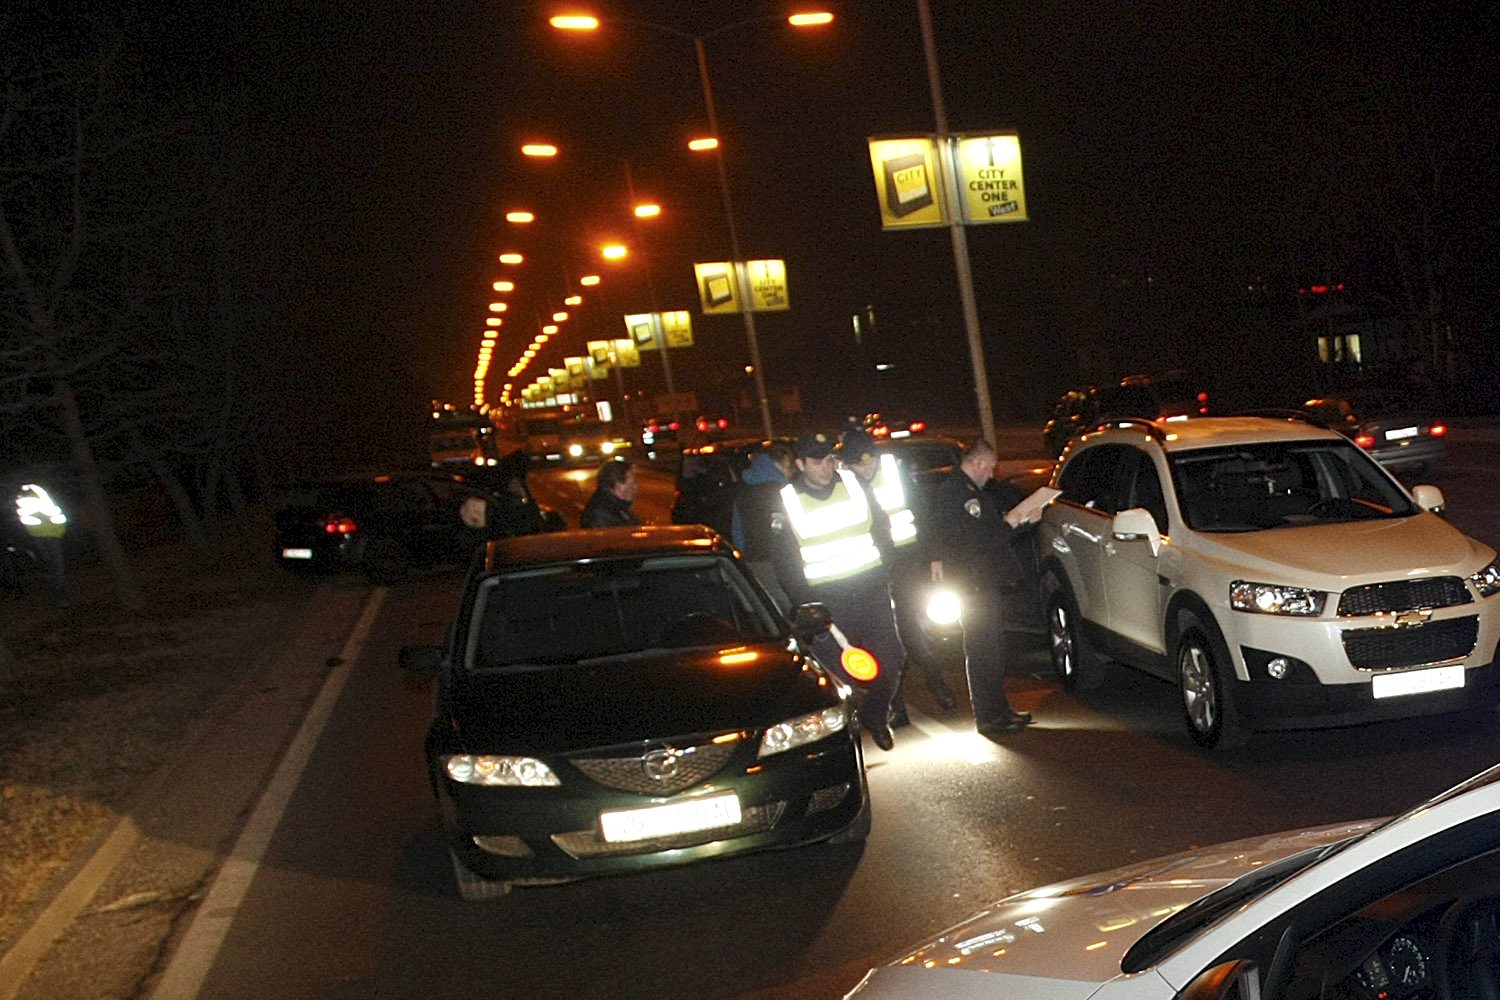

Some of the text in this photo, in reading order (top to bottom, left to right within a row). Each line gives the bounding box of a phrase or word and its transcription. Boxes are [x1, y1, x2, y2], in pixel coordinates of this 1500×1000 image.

[897, 170, 920, 183] CITY
[978, 169, 1004, 179] CITY
[969, 180, 1017, 191] CENTER
[981, 191, 1008, 202] ONE
